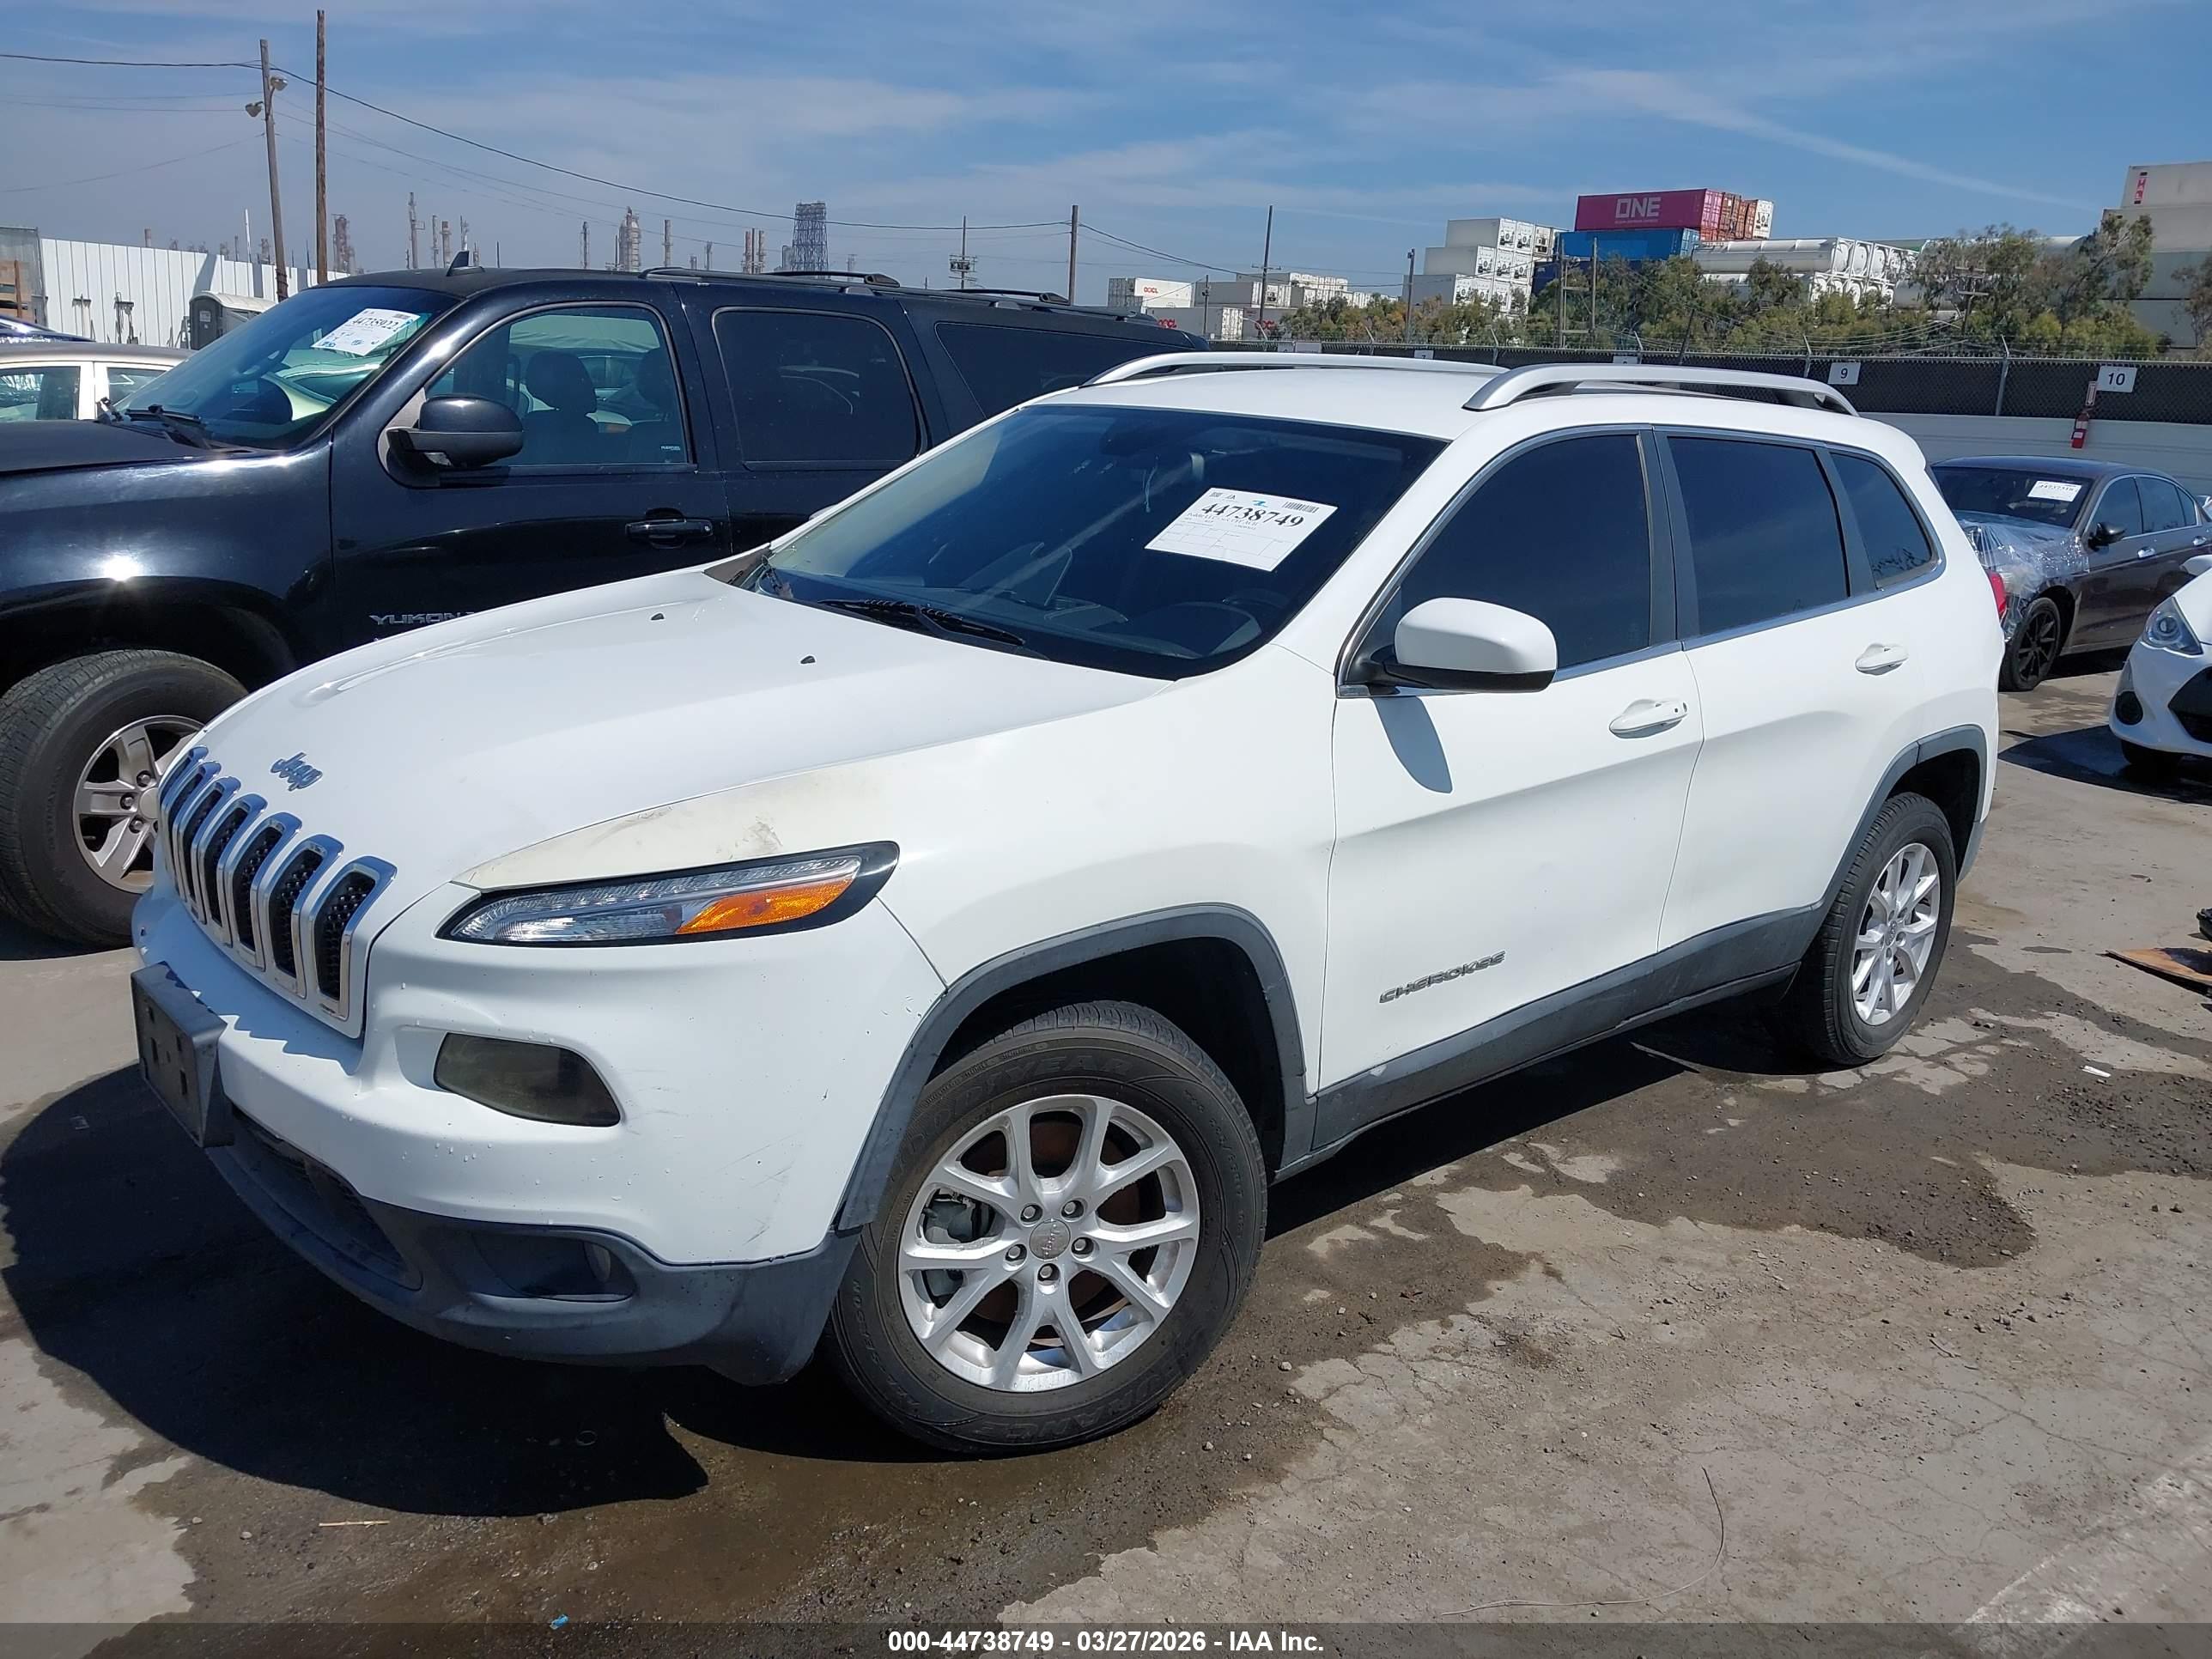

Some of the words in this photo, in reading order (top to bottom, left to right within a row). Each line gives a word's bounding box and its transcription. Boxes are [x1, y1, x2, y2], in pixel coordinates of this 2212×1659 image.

[1615, 197, 1662, 218] ONE
[1840, 368, 1848, 379] 9
[2108, 373, 2125, 386] 10
[1201, 503, 1304, 527] 44738749
[369, 612, 460, 626] YUKON
[270, 751, 324, 792] Jeep
[1379, 950, 1506, 1003] CHEROKEE
